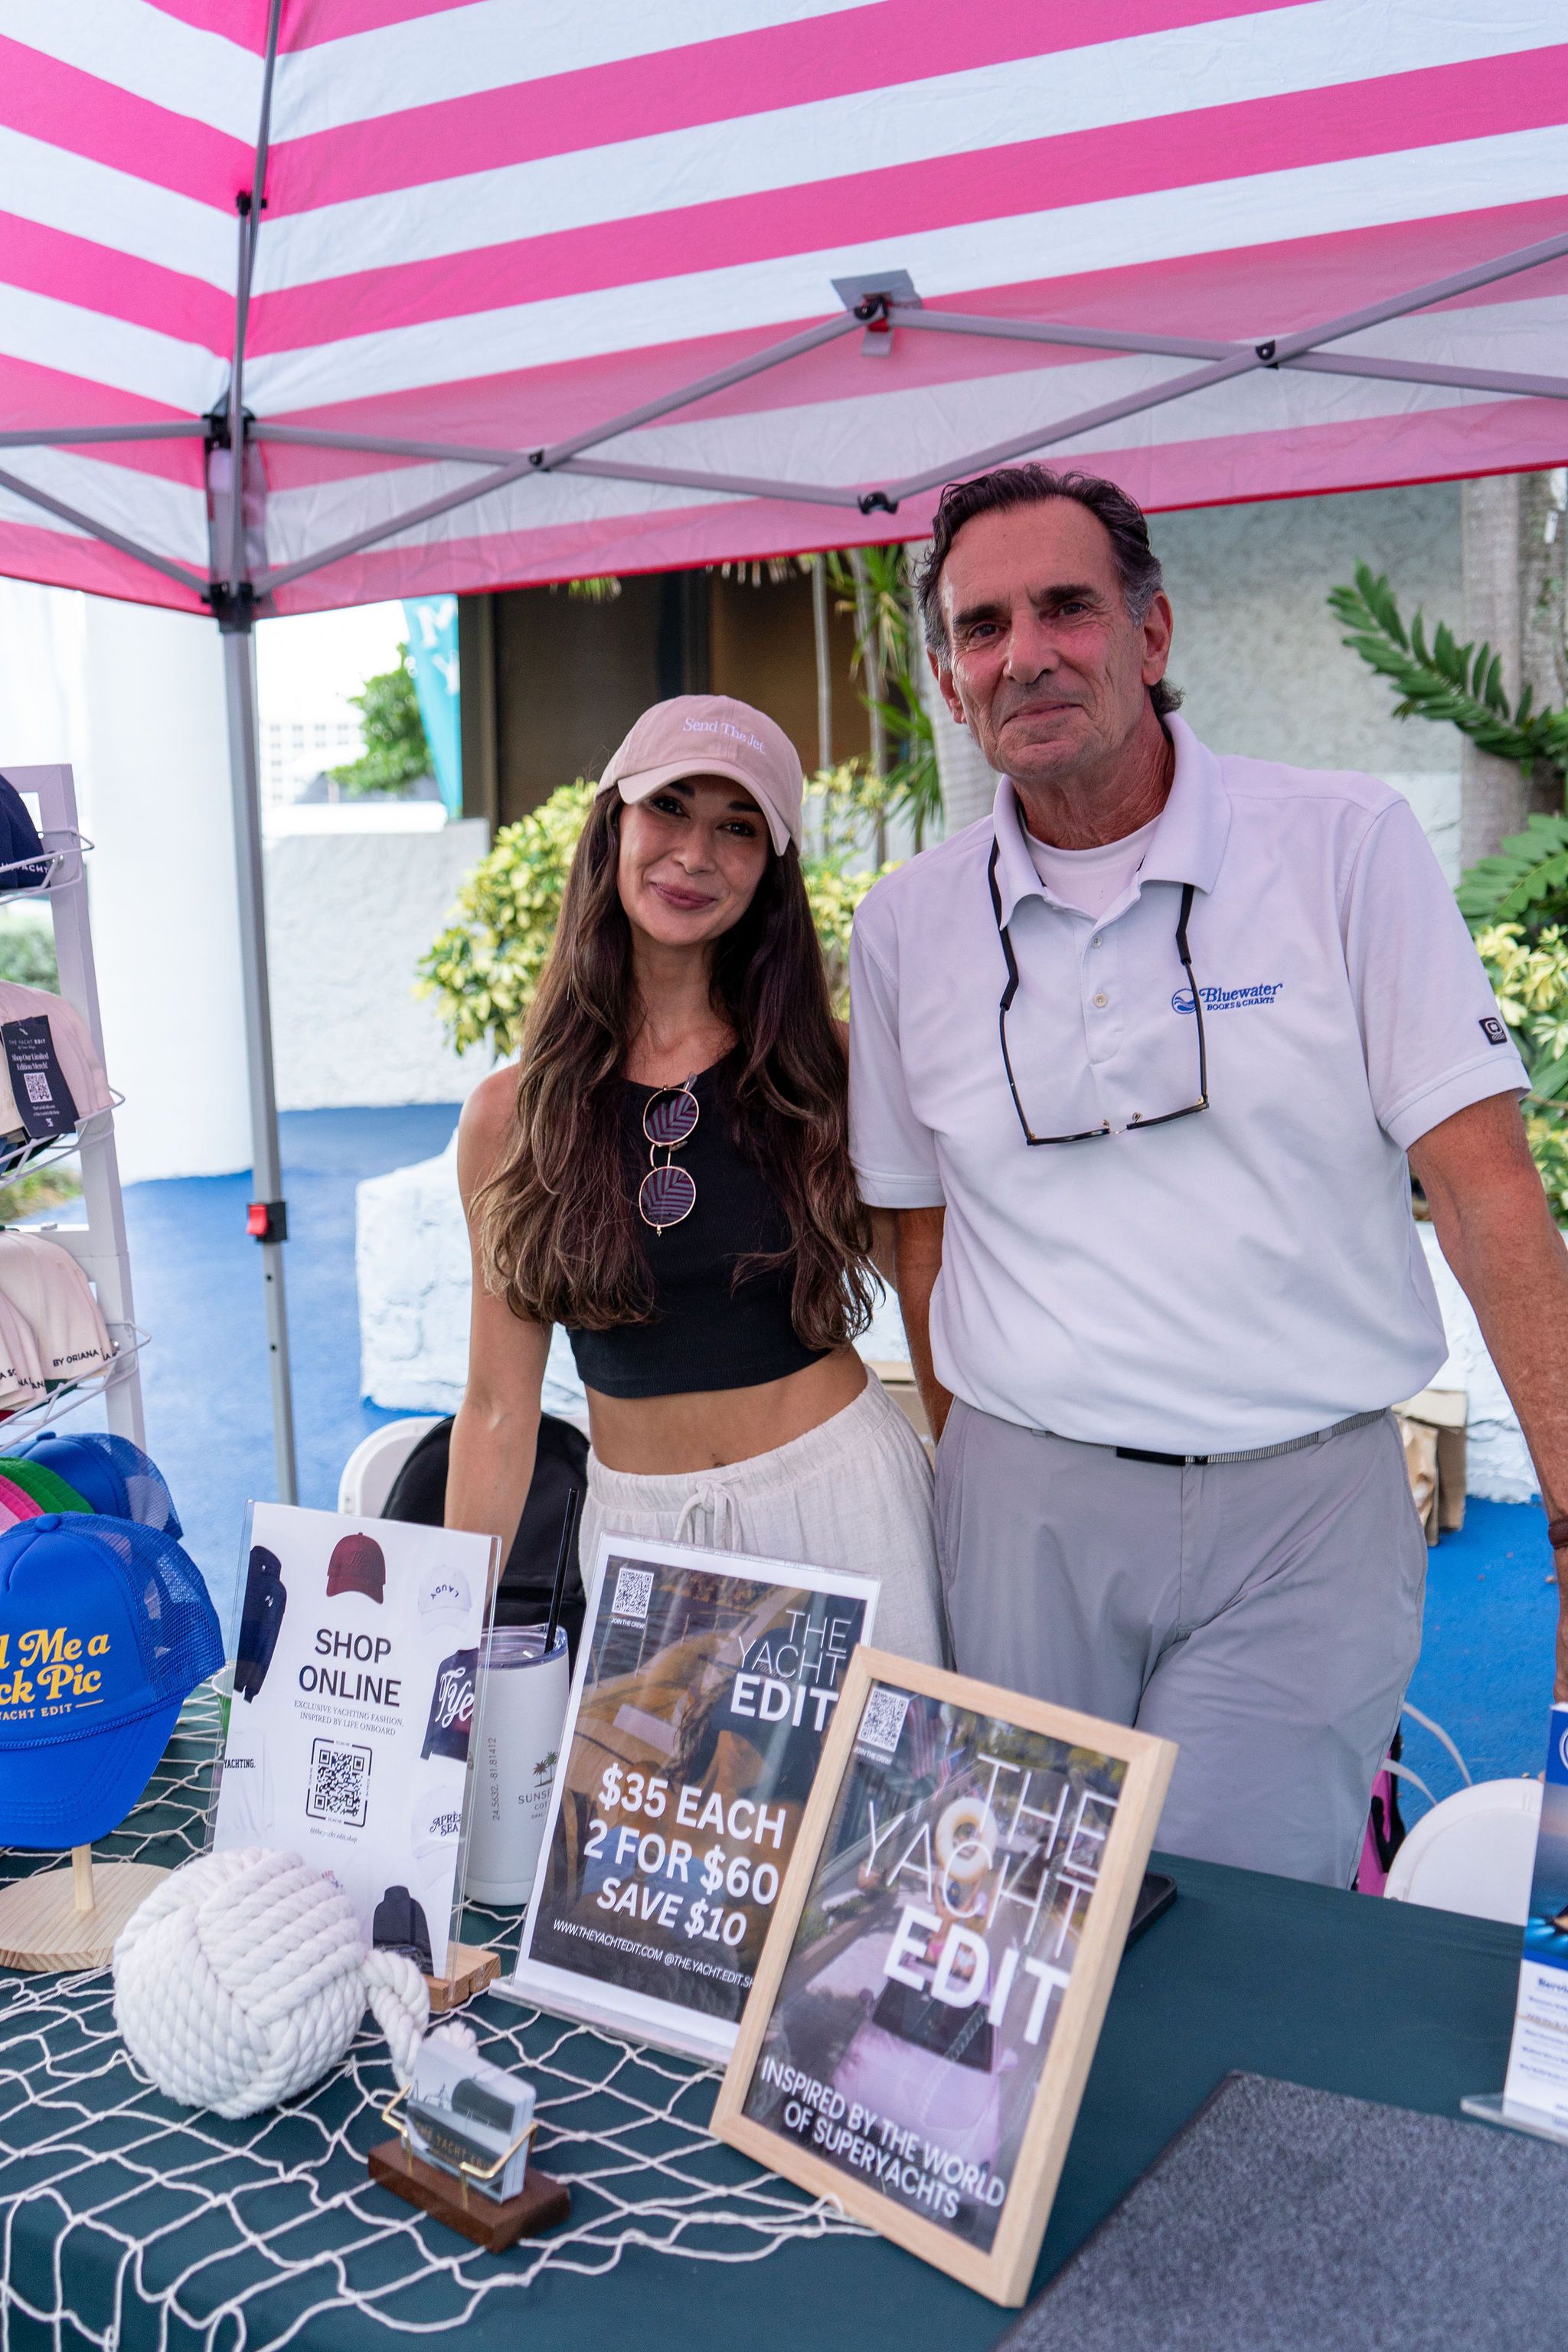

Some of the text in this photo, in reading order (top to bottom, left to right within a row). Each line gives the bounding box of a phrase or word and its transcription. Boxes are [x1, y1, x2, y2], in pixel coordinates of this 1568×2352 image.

[683, 717, 718, 732] Send
[720, 722, 746, 742] The
[1199, 983, 1283, 1002] Bluewater
[1207, 1003, 1235, 1011] BOOKS
[1243, 996, 1275, 1007] CHARTS
[53, 1358, 64, 1367] BY
[66, 1349, 99, 1364] ORIANA
[18, 1627, 83, 1668] Me
[87, 1634, 111, 1657] a
[314, 1628, 392, 1664] SHOP
[785, 1609, 852, 1655] THE
[37, 1663, 102, 1700] Pic
[738, 1635, 847, 1687] YACHT
[299, 1664, 402, 1707] ONLINE
[730, 1672, 840, 1733] EDIT
[41, 1703, 73, 1717] EDIT
[294, 1700, 332, 1713] EXCLUSIVE
[333, 1707, 369, 1720] YACHTING
[300, 1712, 396, 1736] INSPIRED BY LIFE ONBOARD
[599, 1762, 786, 1850] $35 EACH
[977, 1753, 1119, 1879] THE
[440, 1823, 459, 1837] SEA
[583, 1818, 779, 1905] 2 FOR $60
[865, 1801, 1095, 1959] YACHT
[596, 1877, 747, 1946] SAVE $10
[553, 1919, 663, 1962] WWW.THEYACHTEDIT.COM
[884, 1904, 1072, 2046] EDIT
[761, 2056, 1006, 2207] INSPIRED BY THE WORLD
[784, 2101, 960, 2219] OF SUPERYACHTS
